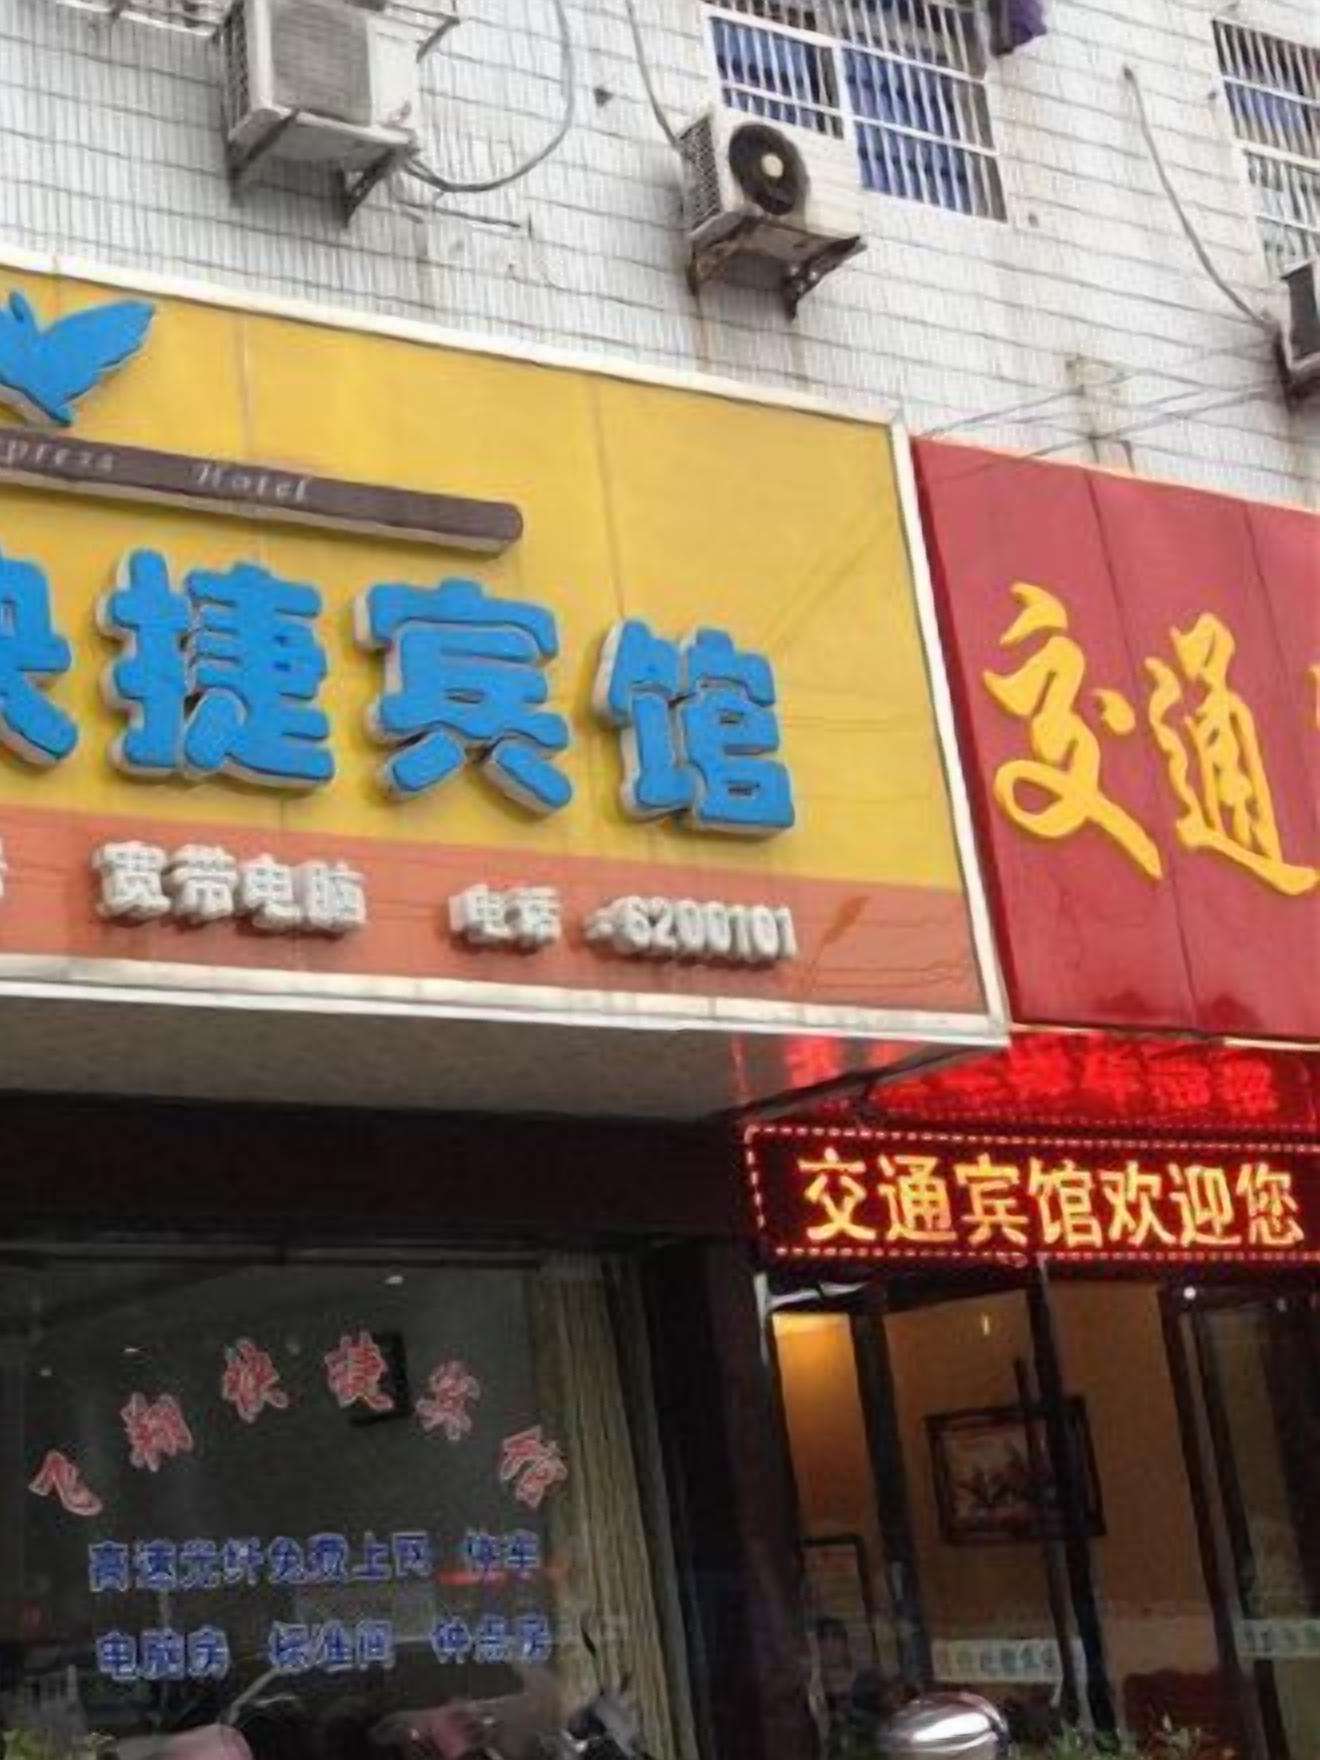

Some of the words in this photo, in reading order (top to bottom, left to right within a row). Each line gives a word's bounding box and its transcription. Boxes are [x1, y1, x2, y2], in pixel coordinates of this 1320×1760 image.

[193, 461, 312, 504] Hotel
[983, 582, 1320, 895] 交通
[92, 840, 368, 934] 宽带电脑
[797, 1147, 1305, 1248] 交通宾馆欢迎您
